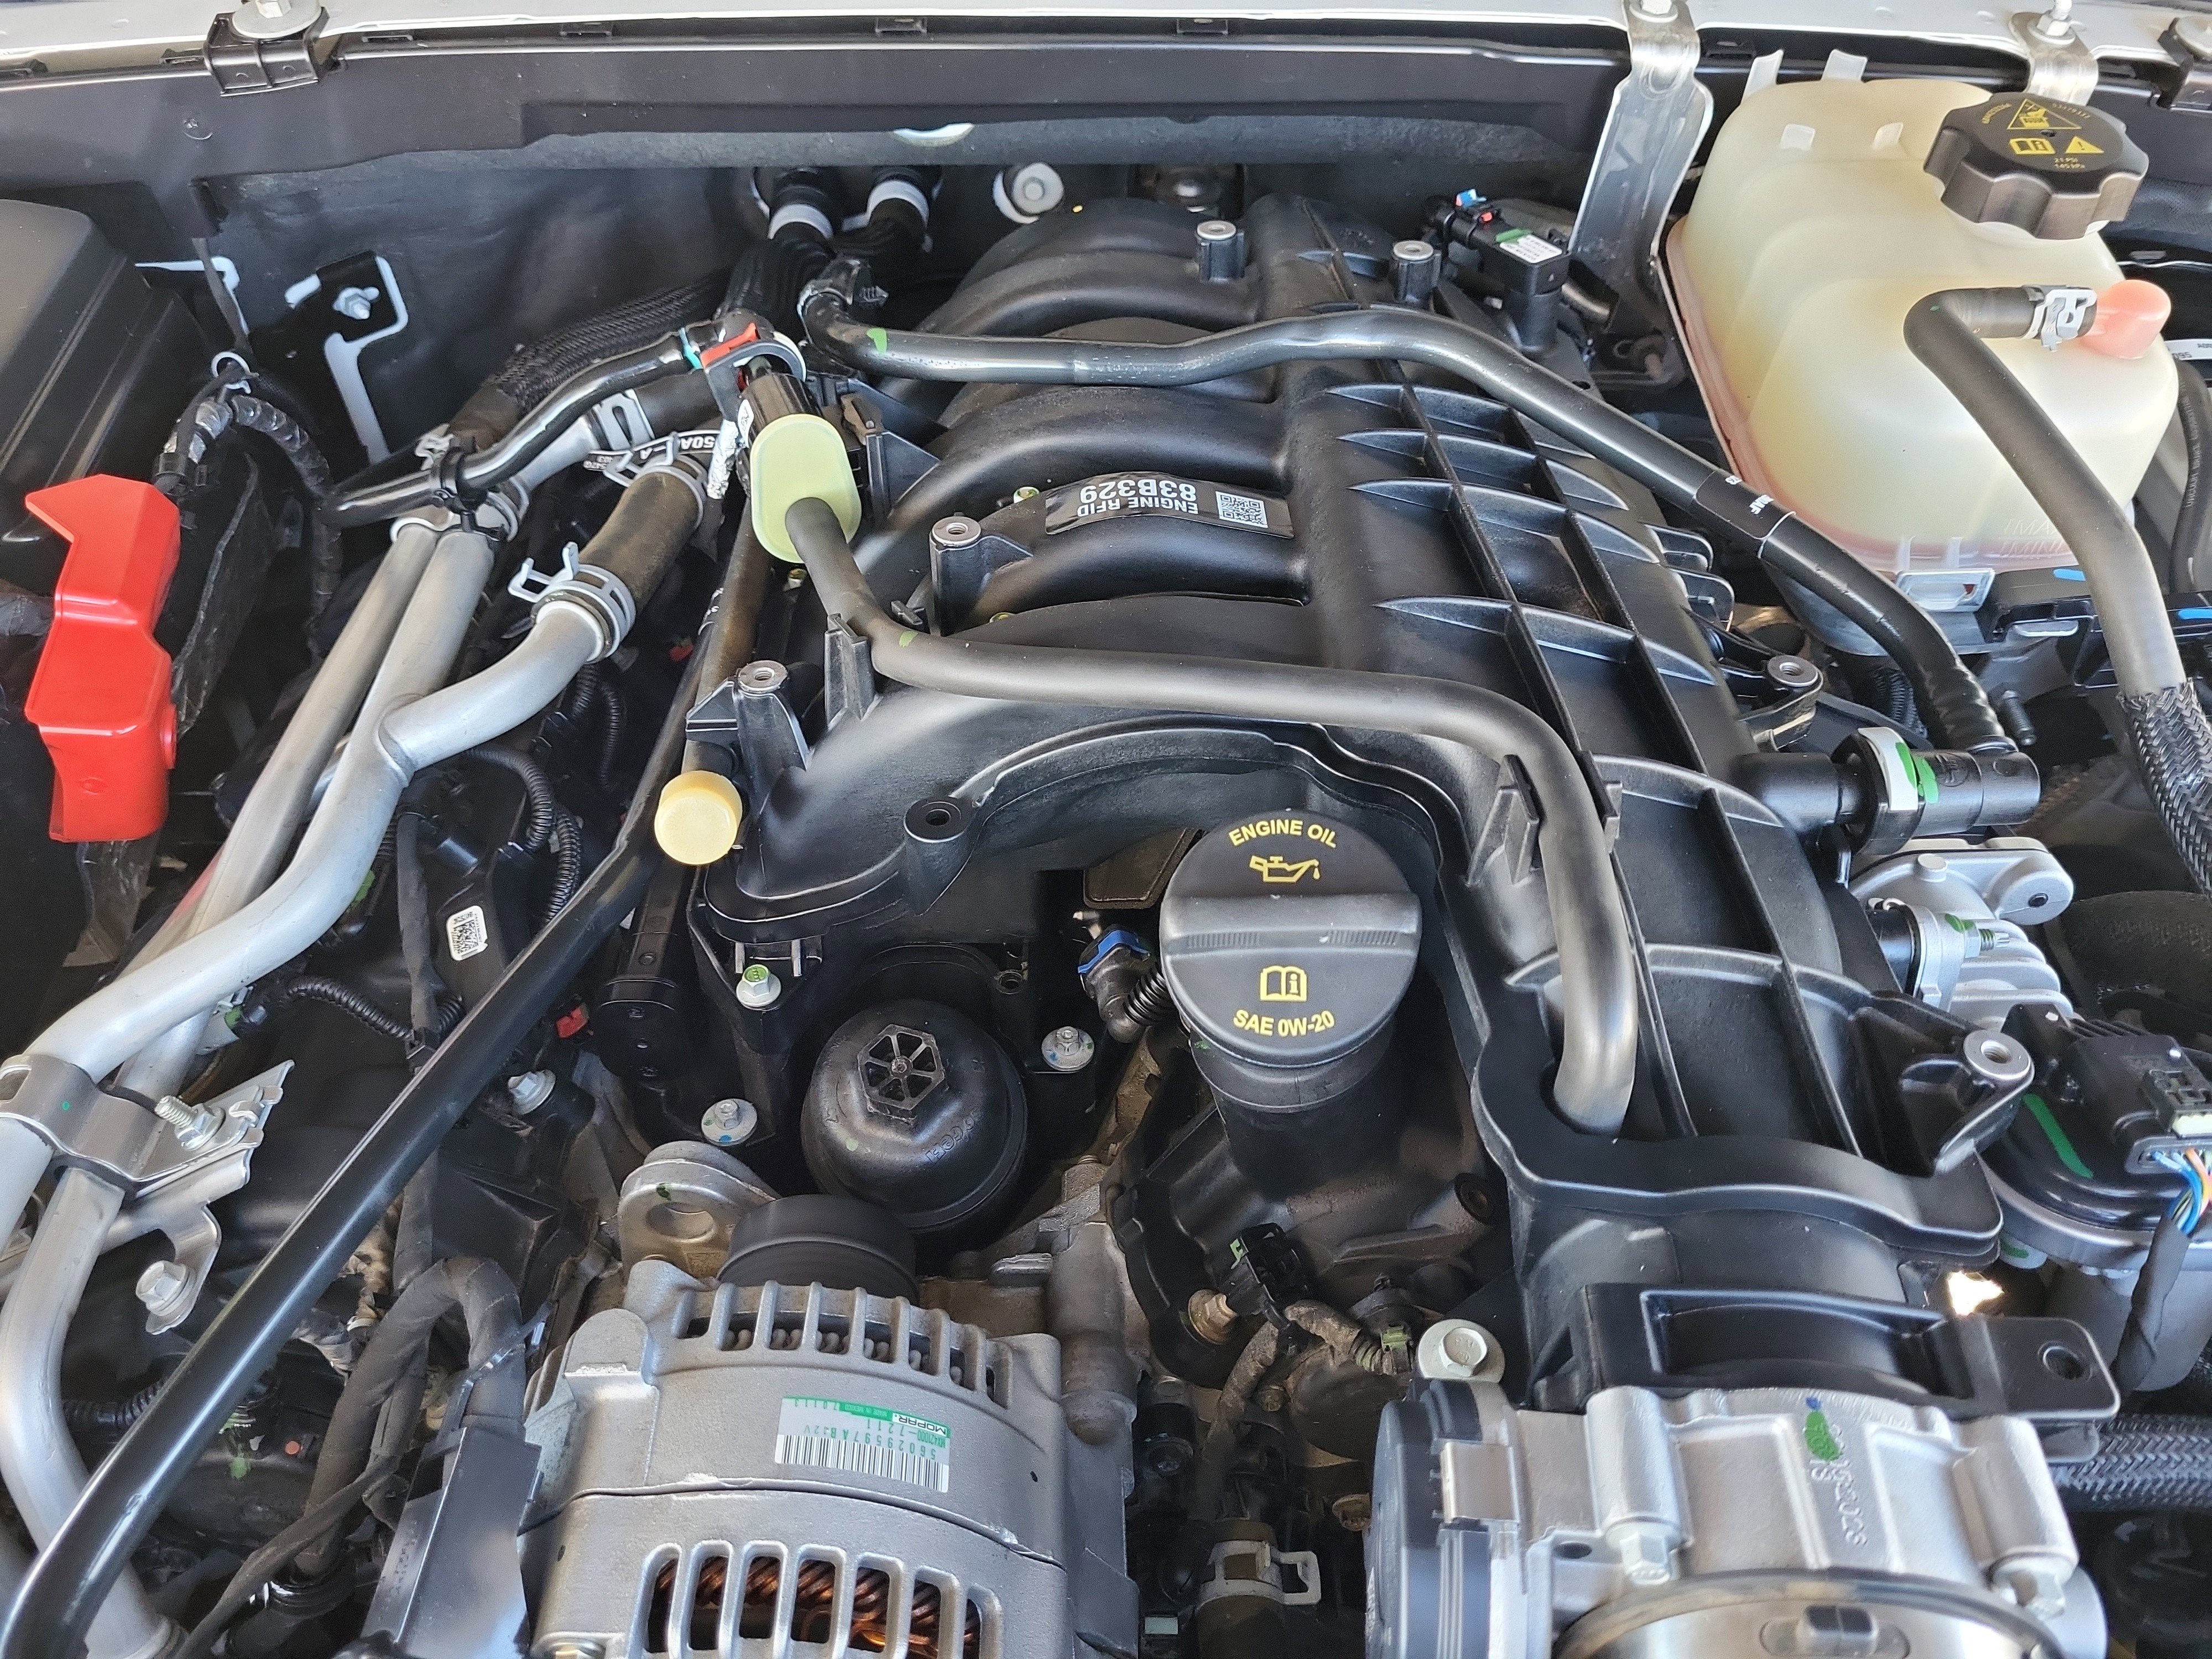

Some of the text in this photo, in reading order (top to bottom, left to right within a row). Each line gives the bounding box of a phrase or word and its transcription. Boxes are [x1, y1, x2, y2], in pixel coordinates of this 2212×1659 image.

[1079, 478, 1197, 504] 83B329
[1077, 496, 1198, 517] ENGINE RFID
[1228, 820, 1338, 849] ENGINE OIL
[1233, 1009, 1335, 1037] SAE 0W-20
